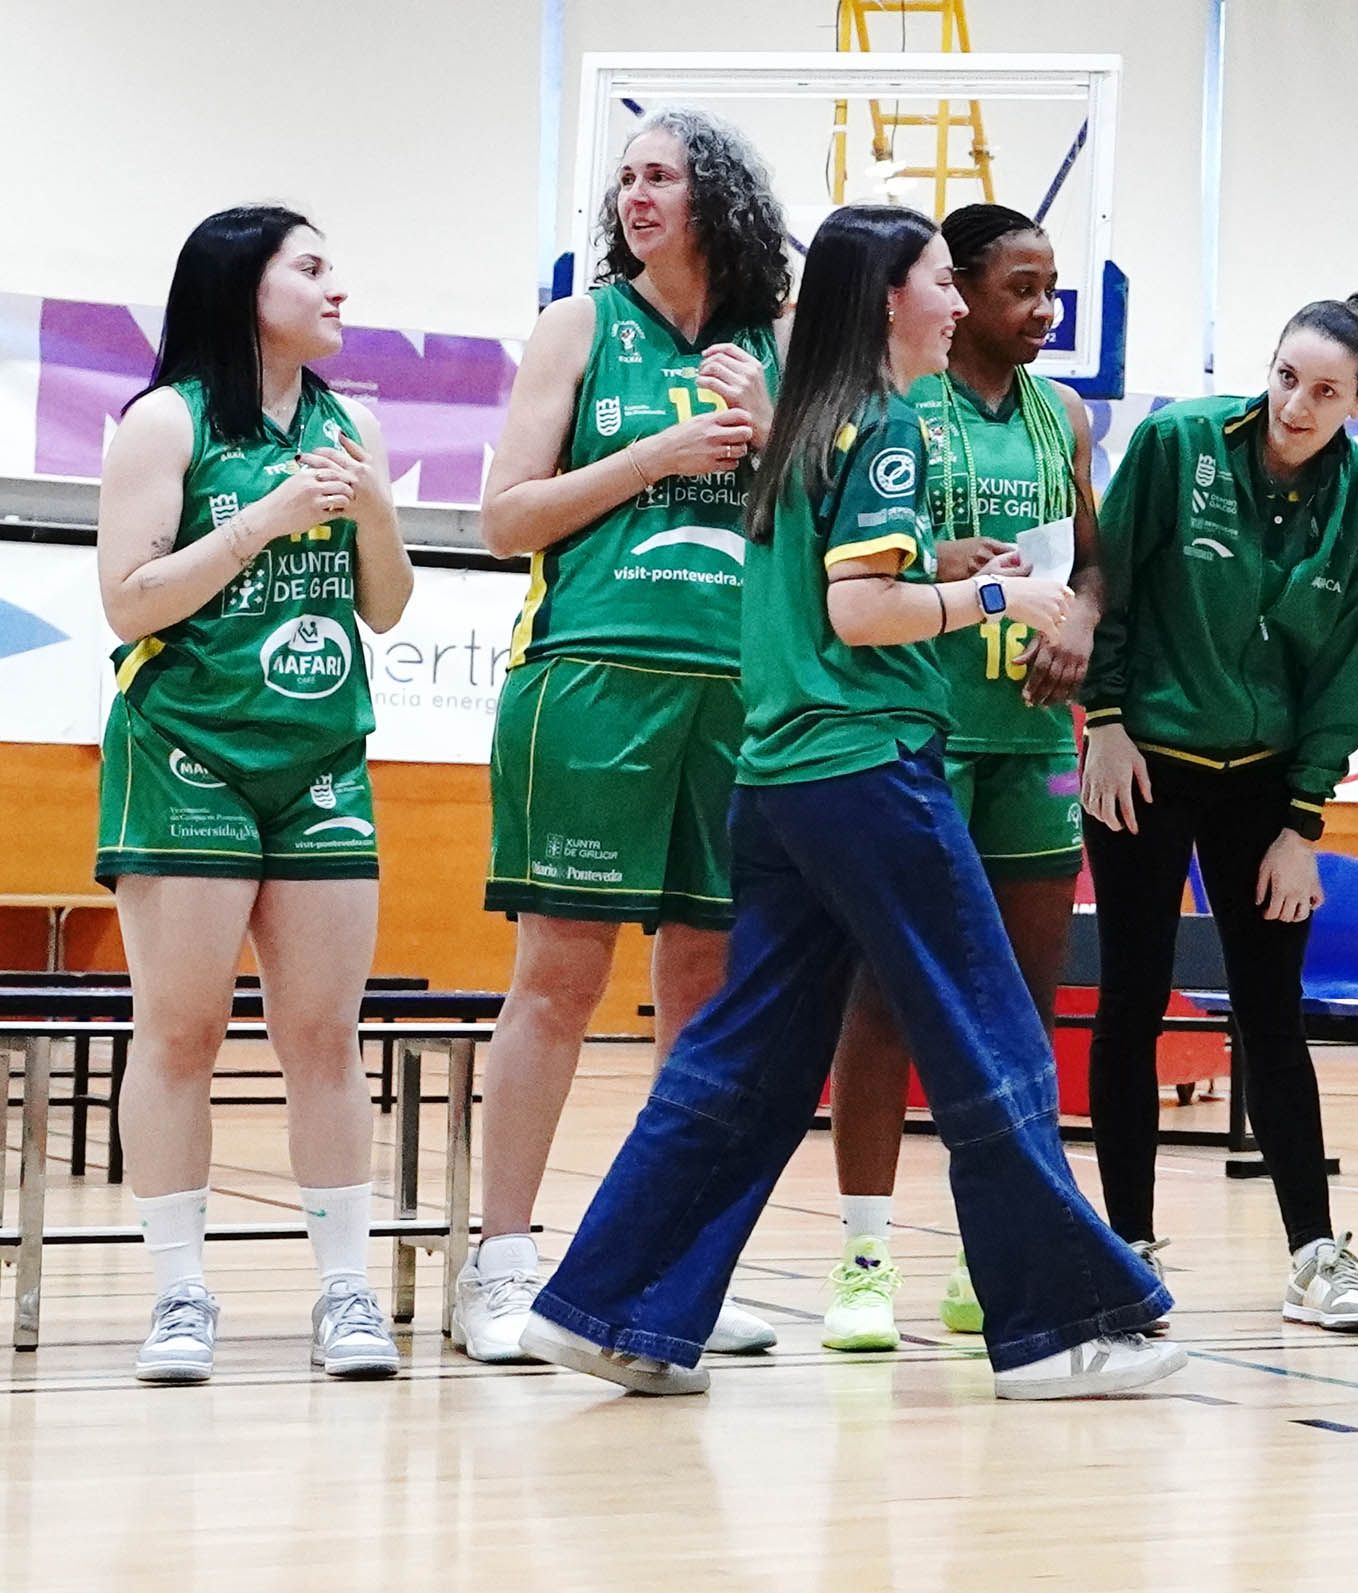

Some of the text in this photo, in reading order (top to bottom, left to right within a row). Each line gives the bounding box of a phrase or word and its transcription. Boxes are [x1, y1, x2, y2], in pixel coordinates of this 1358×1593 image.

[674, 487, 698, 502] DE
[276, 551, 350, 577] XUNTA
[614, 565, 744, 587] visit-pontevedra.
[273, 579, 306, 603] DE
